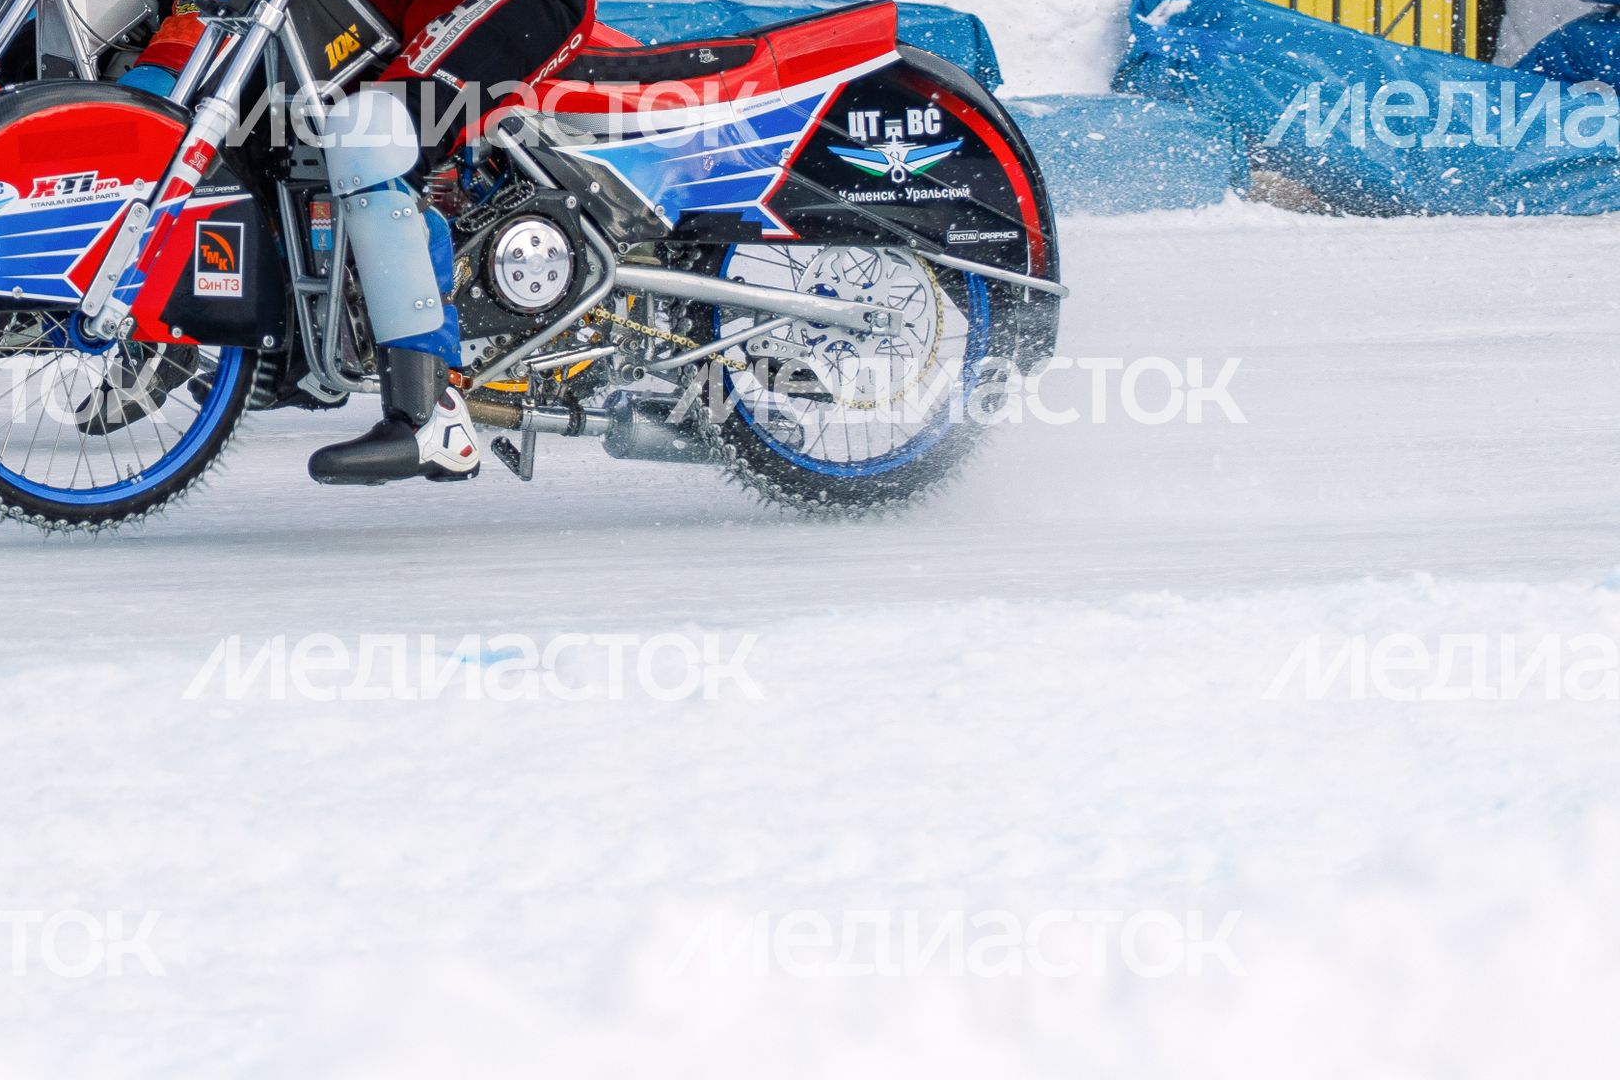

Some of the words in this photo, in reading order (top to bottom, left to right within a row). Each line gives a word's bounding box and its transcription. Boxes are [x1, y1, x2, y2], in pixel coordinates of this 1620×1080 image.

[418, 29, 457, 69] TITANIUM
[848, 110, 880, 139] ЦТ
[906, 107, 942, 135] ВС
[30, 199, 66, 209] TITANIUM
[66, 195, 94, 205] ENGINE
[95, 191, 120, 201] PARTS
[838, 188, 896, 203] Каменск
[904, 183, 971, 202] Уральский
[200, 245, 228, 271] ТМК
